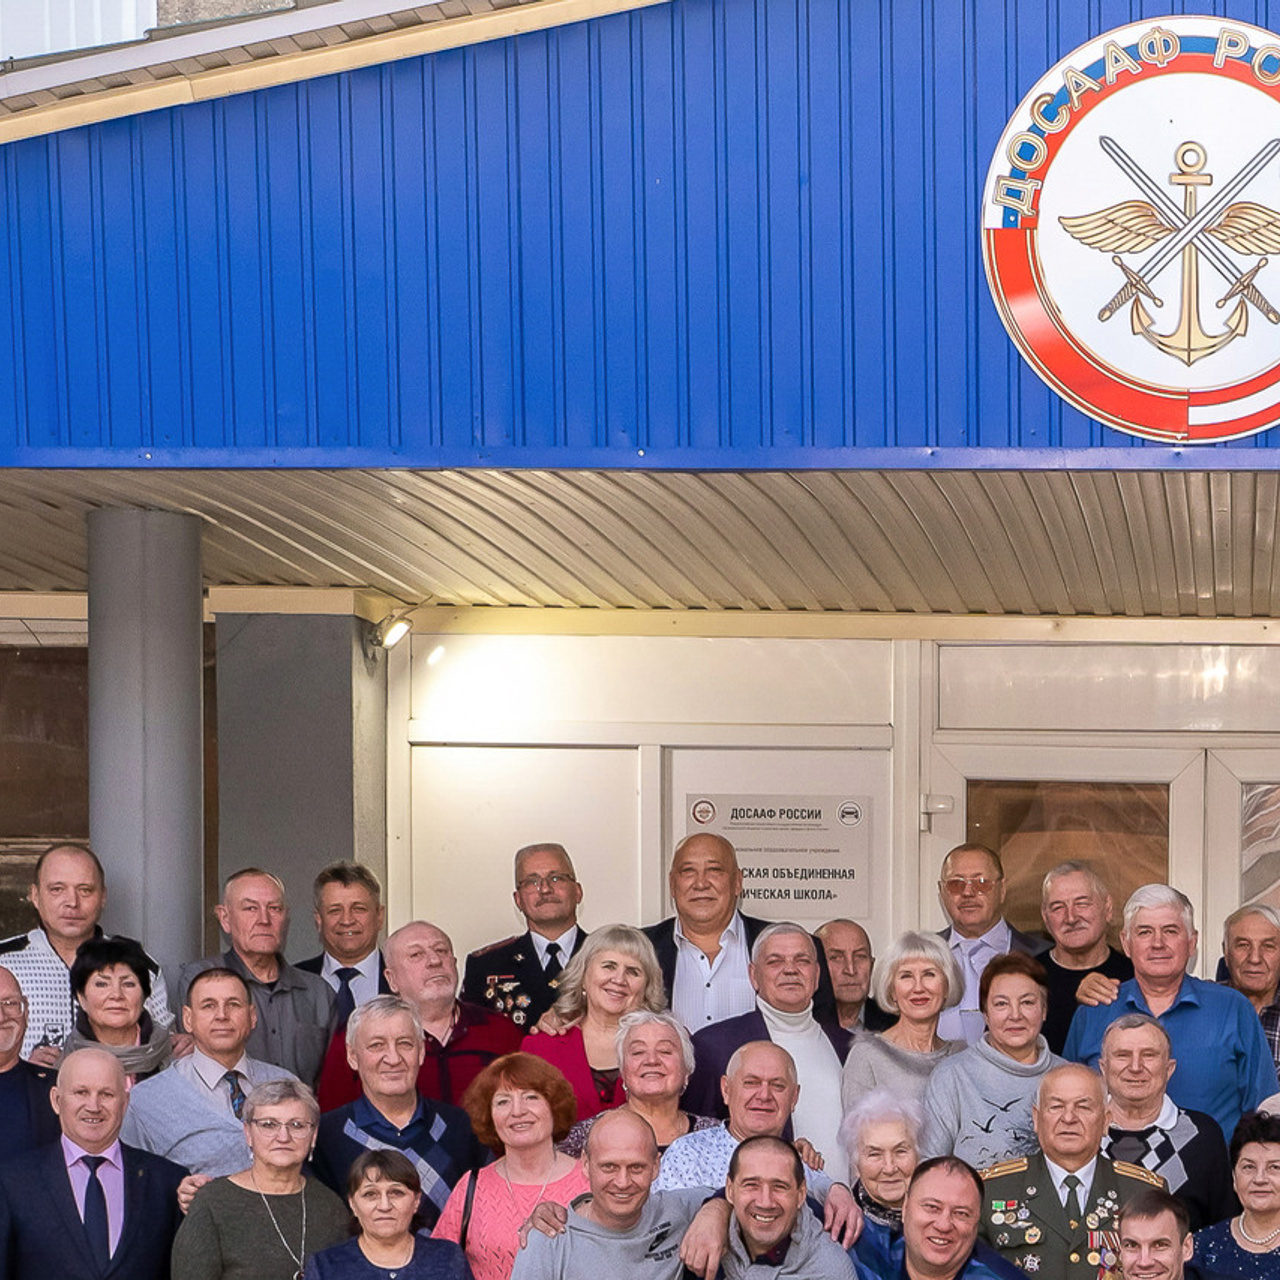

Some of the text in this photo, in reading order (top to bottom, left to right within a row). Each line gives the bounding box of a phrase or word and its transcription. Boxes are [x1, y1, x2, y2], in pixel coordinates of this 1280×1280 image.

[993, 26, 1181, 218] ДОСААФ
[730, 808, 822, 819] ДОСААФ РОССИИ
[741, 868, 855, 880] СКАЯ ОБЪЕДИНЕННАЯ
[740, 888, 791, 900] ИЧЕСКАЯ
